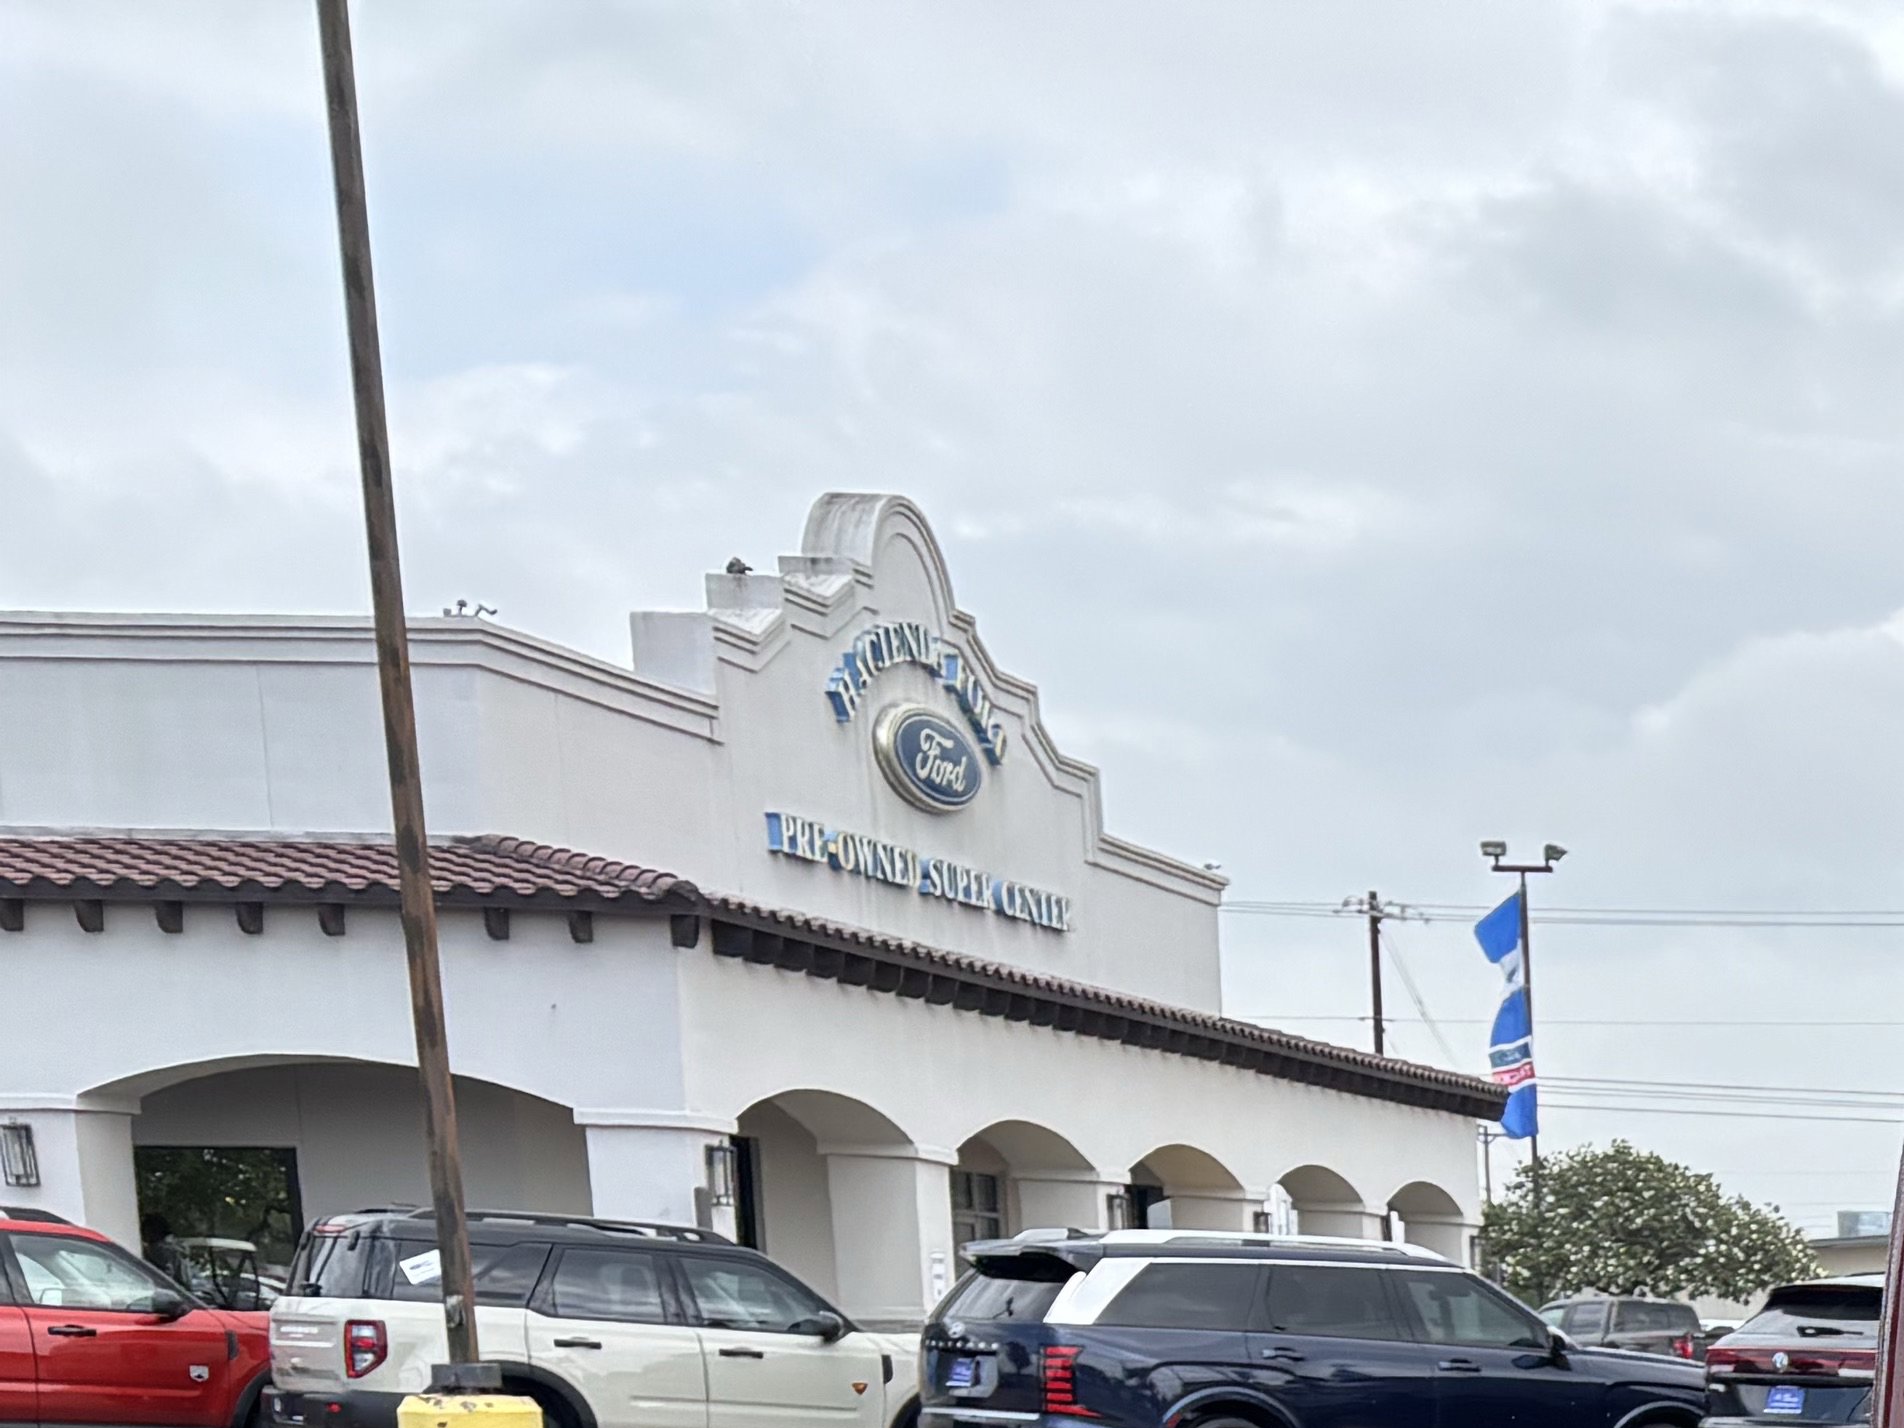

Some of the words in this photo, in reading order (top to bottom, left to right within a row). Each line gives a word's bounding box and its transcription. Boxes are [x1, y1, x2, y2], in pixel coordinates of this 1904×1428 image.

[915, 727, 967, 793] Ford
[766, 812, 922, 889] PRE-OWNED
[919, 858, 994, 910] SUPER
[992, 880, 1070, 931] CENTER
